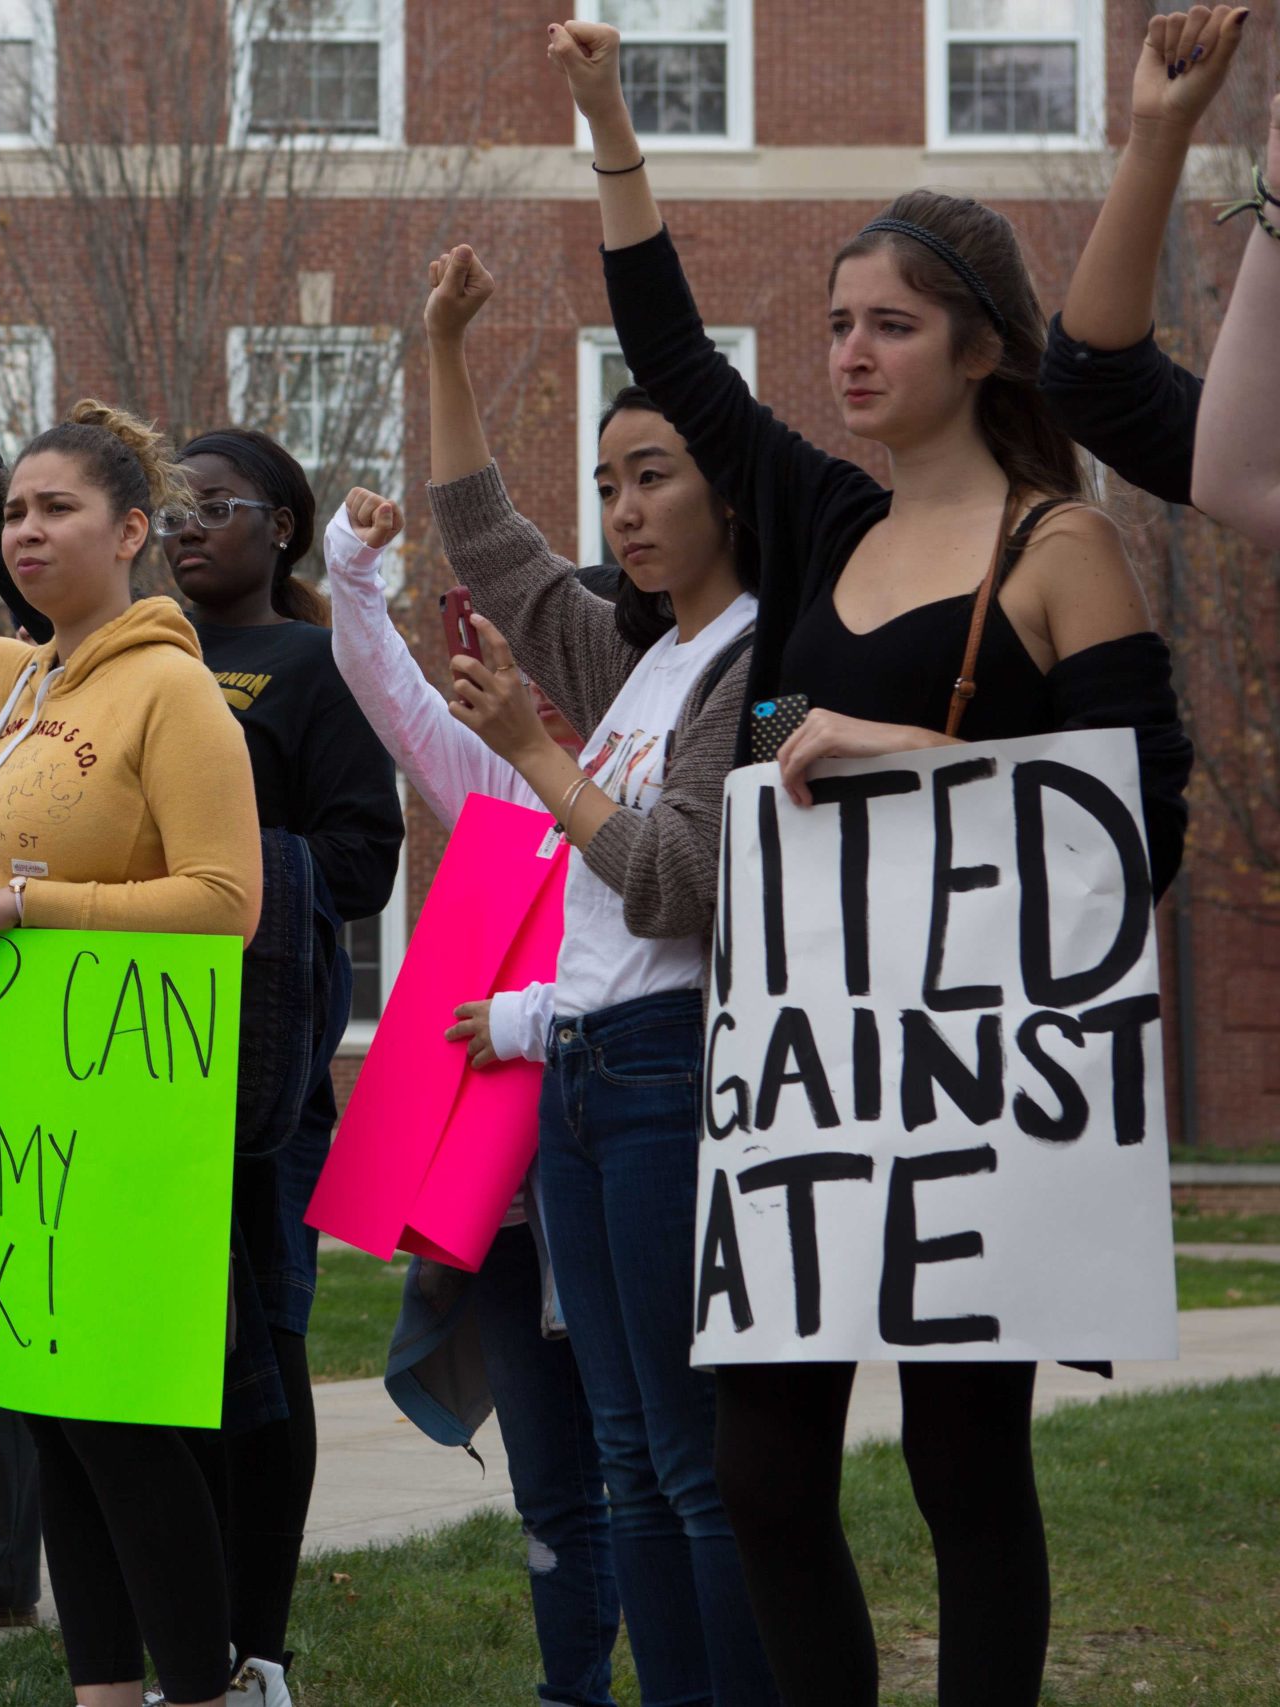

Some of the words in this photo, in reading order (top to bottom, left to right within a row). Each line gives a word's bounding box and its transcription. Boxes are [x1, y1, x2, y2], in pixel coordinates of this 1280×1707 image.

[64, 728, 80, 743] &
[74, 742, 98, 777] CO.
[18, 832, 39, 849] ST
[63, 951, 216, 1083] CAN
